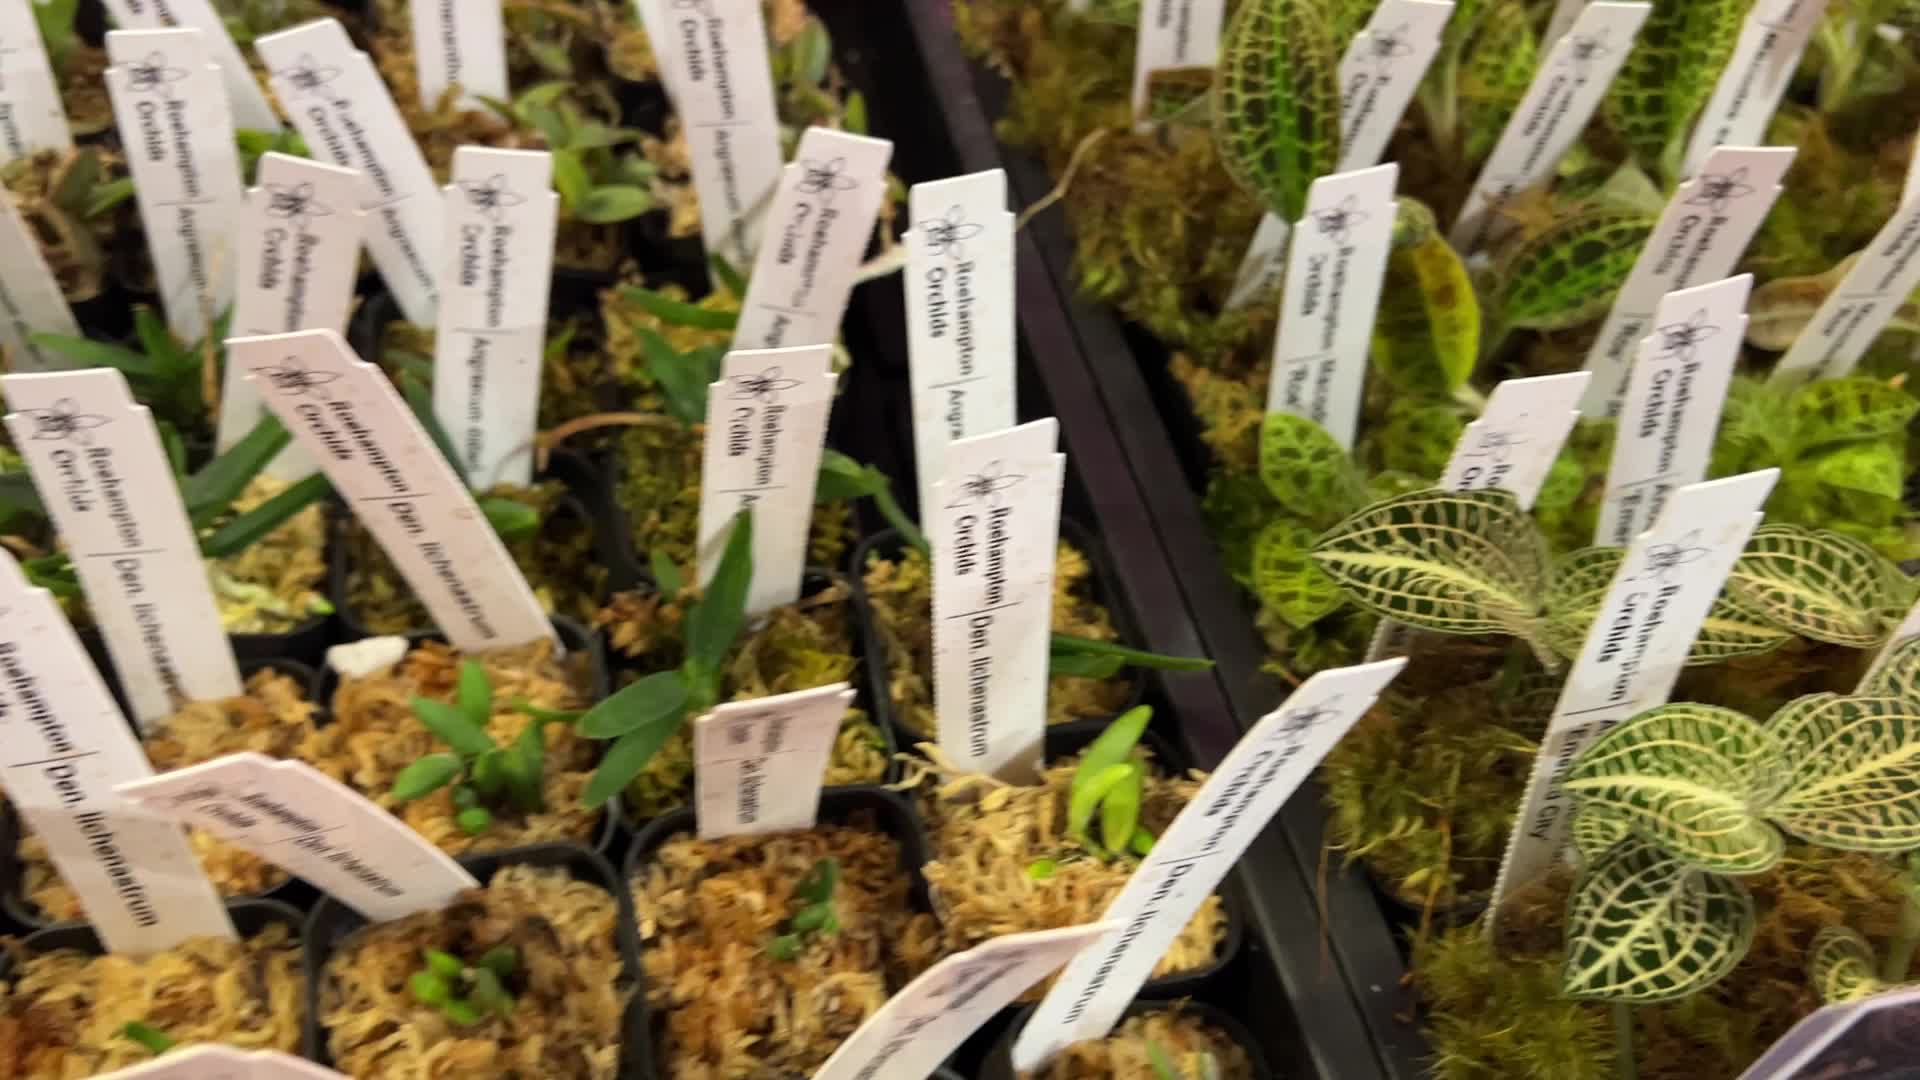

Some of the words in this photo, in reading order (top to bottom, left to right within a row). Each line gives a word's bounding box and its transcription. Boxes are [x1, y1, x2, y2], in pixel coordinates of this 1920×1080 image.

[925, 266, 951, 339] Orchids
[955, 259, 977, 377] Roehampton
[728, 406, 755, 458] Orchids
[1639, 368, 1673, 439] Orchids
[954, 514, 979, 577] Orchids
[984, 506, 1013, 606] Roehampton
[1598, 592, 1649, 665] Orchids
